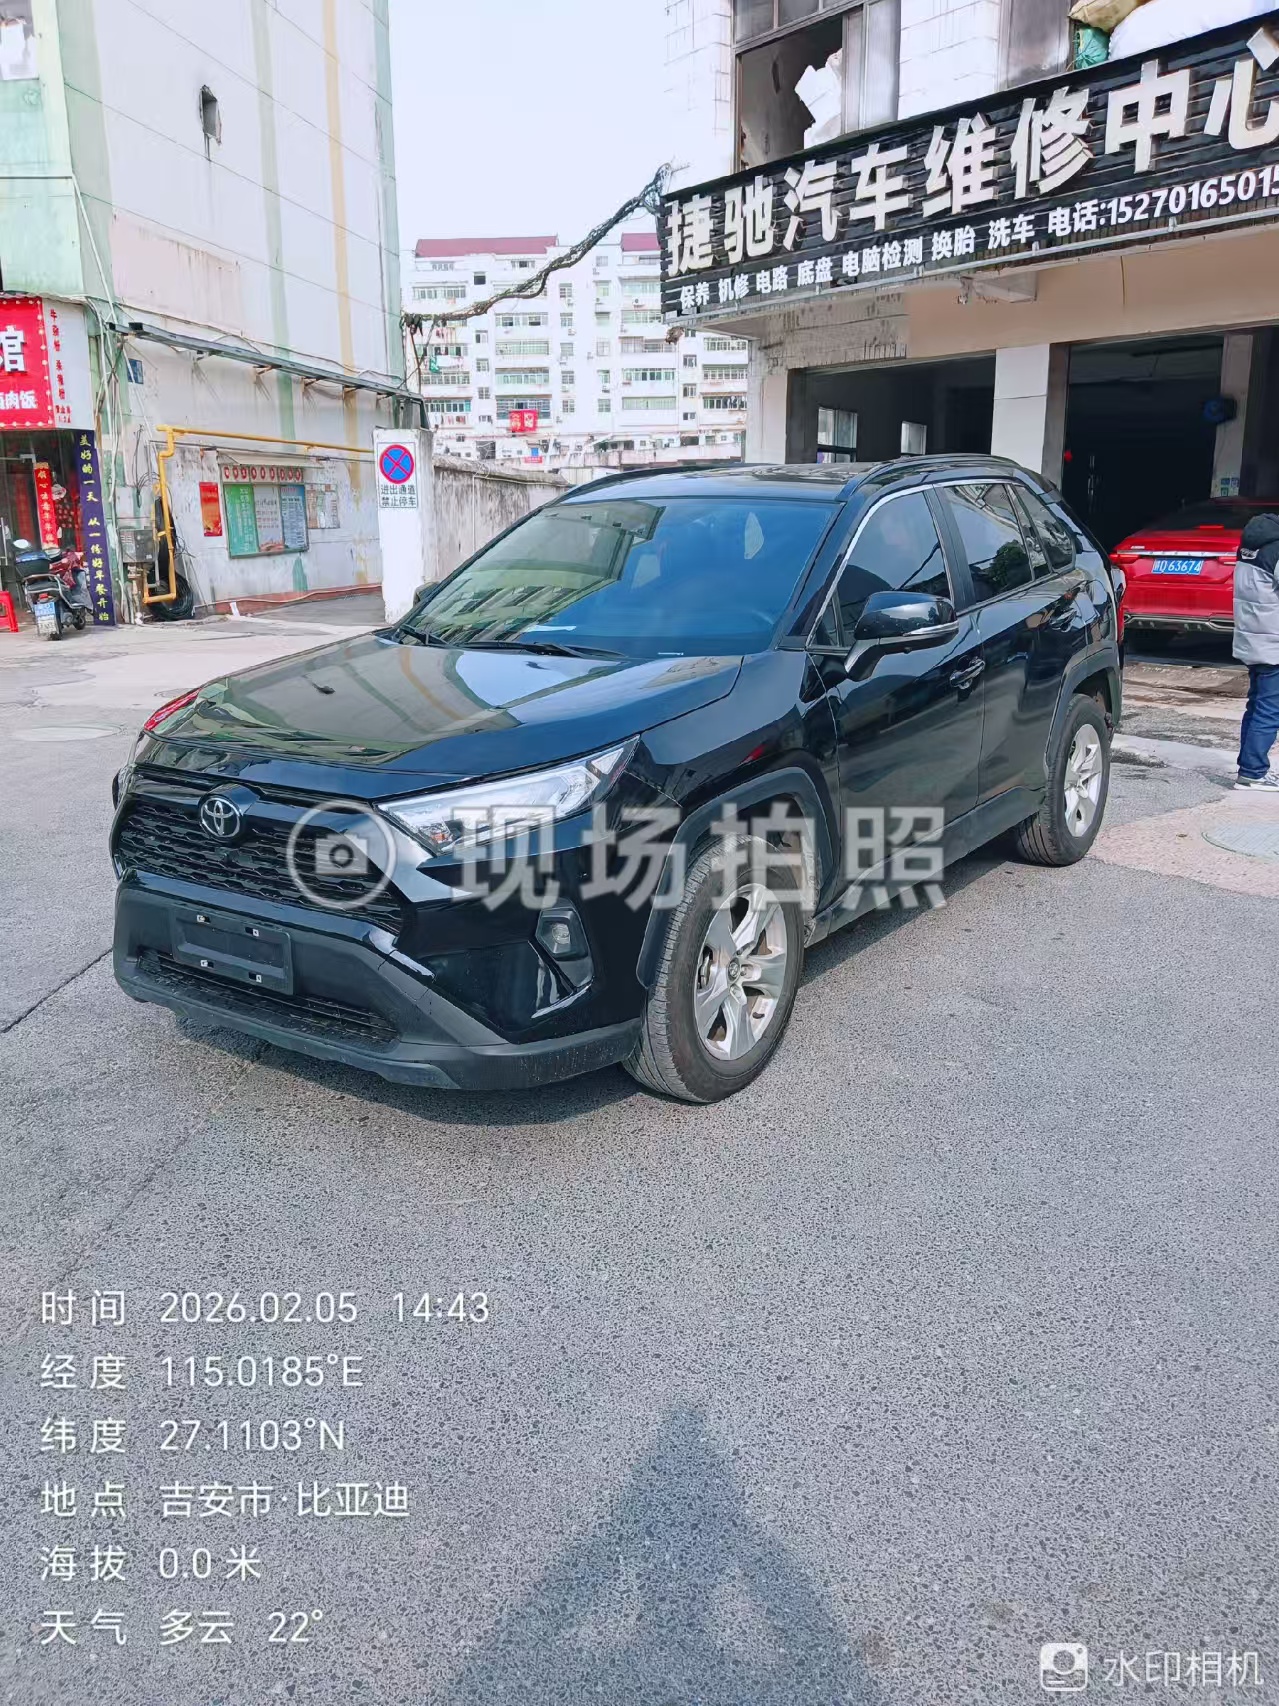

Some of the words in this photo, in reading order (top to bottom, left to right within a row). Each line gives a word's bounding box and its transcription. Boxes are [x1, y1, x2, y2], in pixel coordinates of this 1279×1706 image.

[664, 26, 1279, 276] 捷驰汽车维修中心
[680, 282, 710, 309] 保养
[718, 273, 749, 303] 机修
[756, 266, 788, 294] 电路
[797, 256, 833, 286] 底盘
[842, 236, 923, 278] 电脑检测
[932, 219, 975, 262] 换胎
[988, 213, 1035, 250] 洗车
[381, 484, 416, 495] 进出通道
[382, 496, 416, 507] 禁止停车
